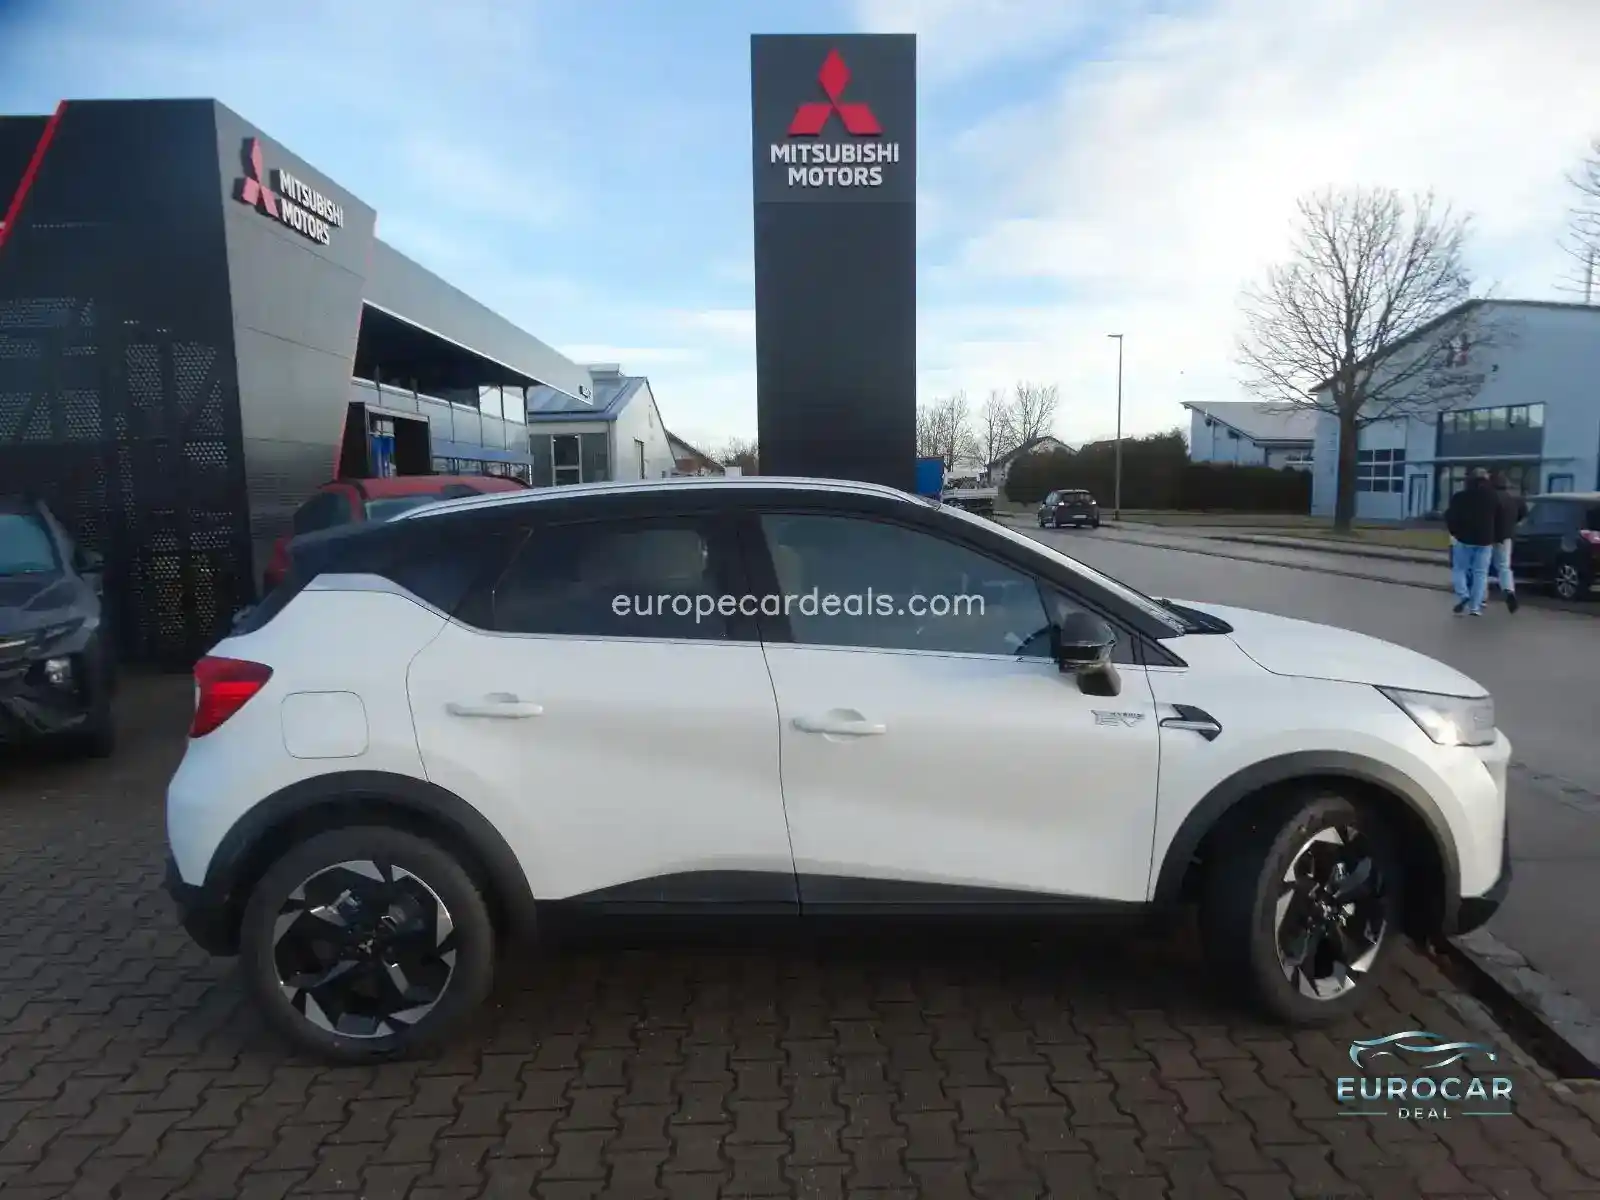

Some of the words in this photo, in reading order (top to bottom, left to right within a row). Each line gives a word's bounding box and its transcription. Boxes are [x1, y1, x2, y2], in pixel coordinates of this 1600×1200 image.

[770, 142, 900, 164] MITSUBISHI
[788, 166, 883, 187] MOTORS
[279, 167, 344, 229] MITSUBISHI
[280, 198, 330, 246] MOTORS
